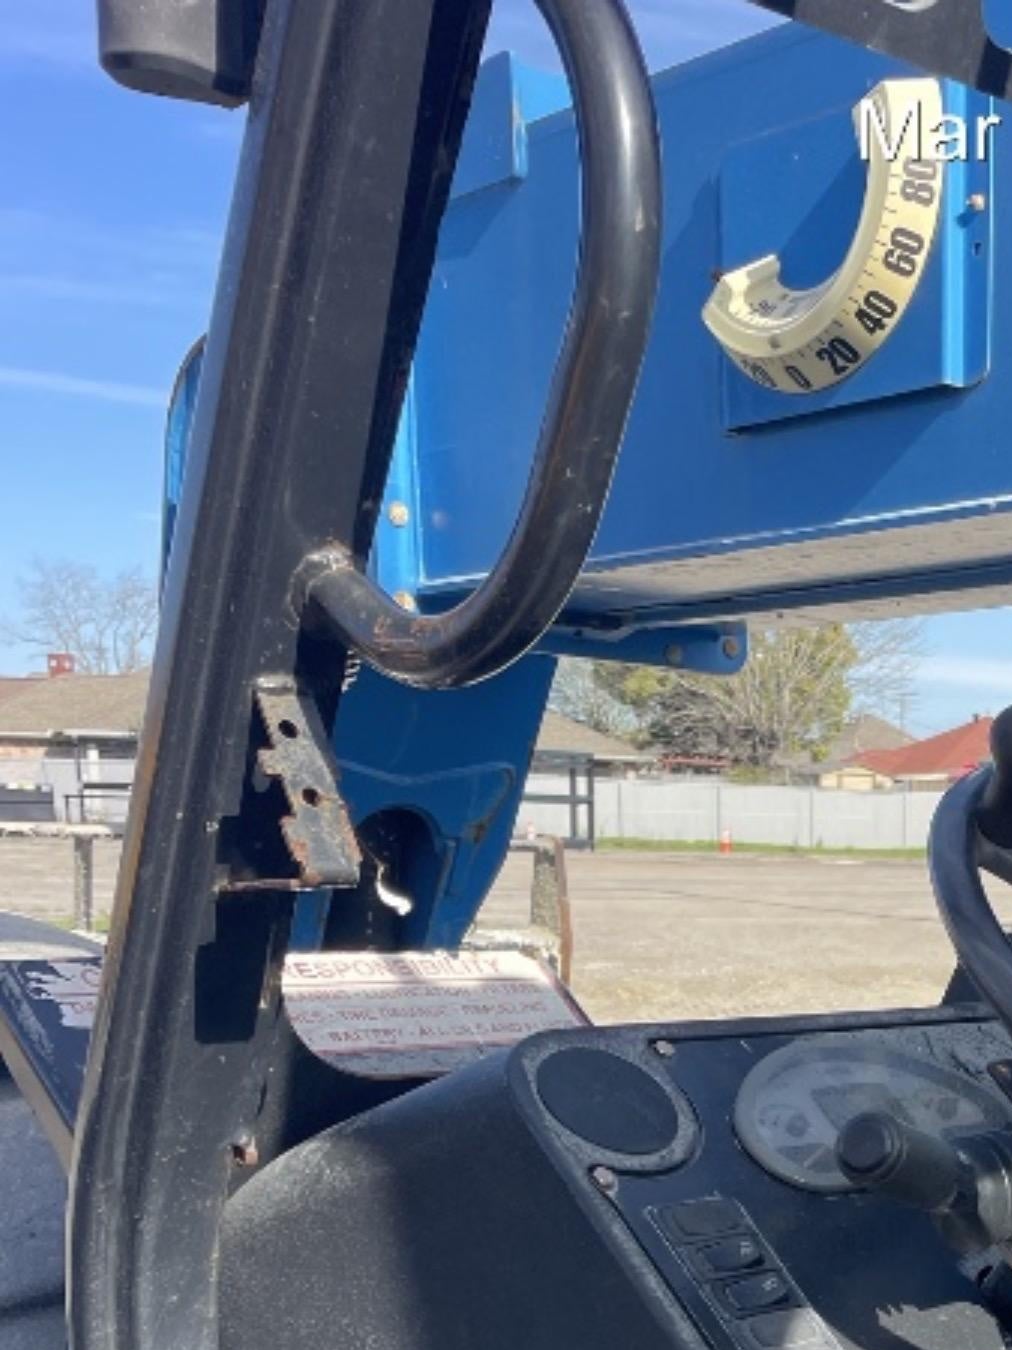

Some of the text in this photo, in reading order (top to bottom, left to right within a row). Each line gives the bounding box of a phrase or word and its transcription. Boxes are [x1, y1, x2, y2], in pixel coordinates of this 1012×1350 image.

[882, 227, 925, 278] 60
[855, 290, 898, 335] 40
[816, 337, 861, 375] 20
[785, 365, 813, 389] 0
